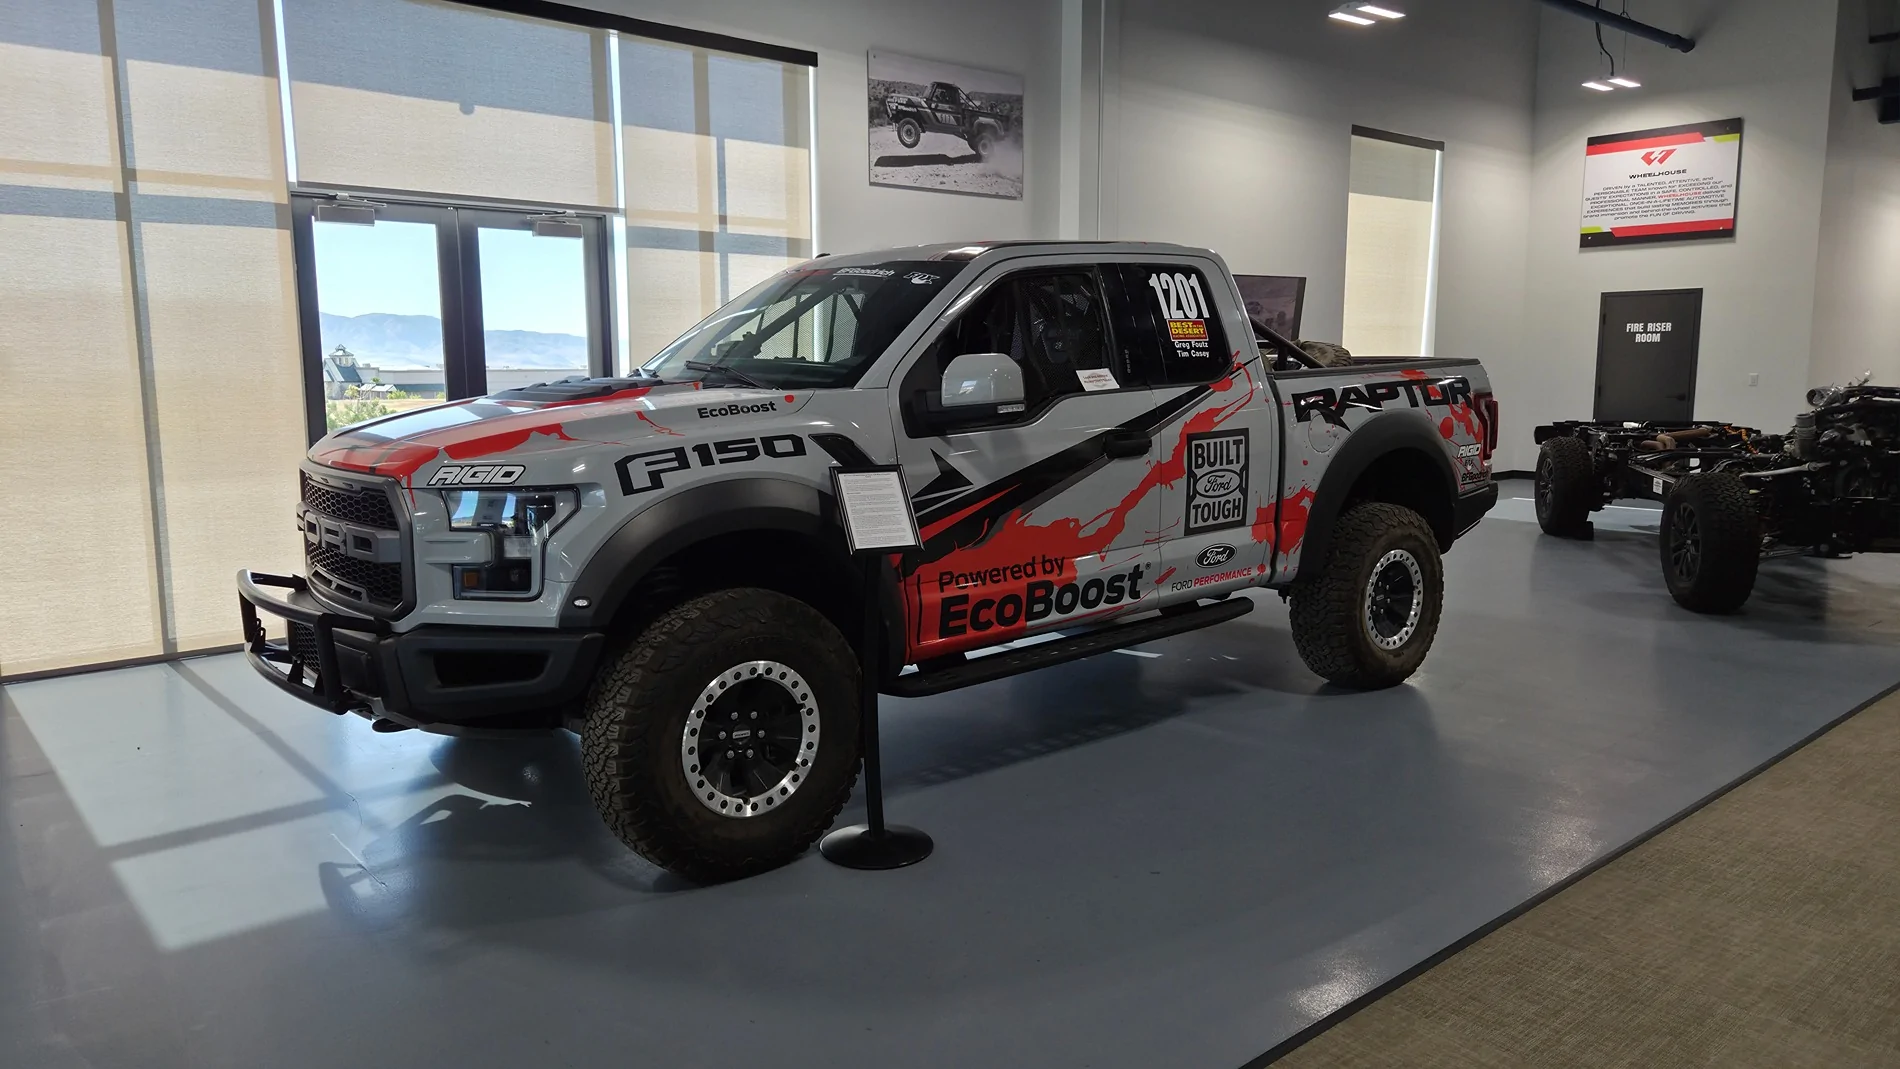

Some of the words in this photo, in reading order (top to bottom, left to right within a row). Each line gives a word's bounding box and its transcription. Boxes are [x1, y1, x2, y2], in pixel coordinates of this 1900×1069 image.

[1629, 169, 1687, 179] WHEELHOUSE
[1658, 191, 1702, 199] WHEELHOUSE
[1148, 273, 1210, 319] 1201
[1626, 323, 1644, 333] FIRE
[1647, 322, 1672, 332] RISER
[1174, 341, 1190, 350] Greg
[1635, 333, 1660, 343] ROOM
[1177, 350, 1189, 358] Tim
[1191, 350, 1210, 358] Casey
[697, 401, 777, 420] EcoBoost
[1291, 376, 1474, 433] RAPTOR
[1194, 438, 1244, 470] BUILT
[1457, 443, 1482, 459] RIGID
[426, 464, 527, 487] RIGID
[1203, 474, 1233, 494] Ford
[1192, 497, 1242, 525] TOUGH
[1203, 547, 1230, 565] Ford
[938, 555, 1036, 593] Powered
[1041, 554, 1066, 577] by
[1171, 580, 1192, 592] FORD
[1193, 567, 1252, 587] PERFORMANCE
